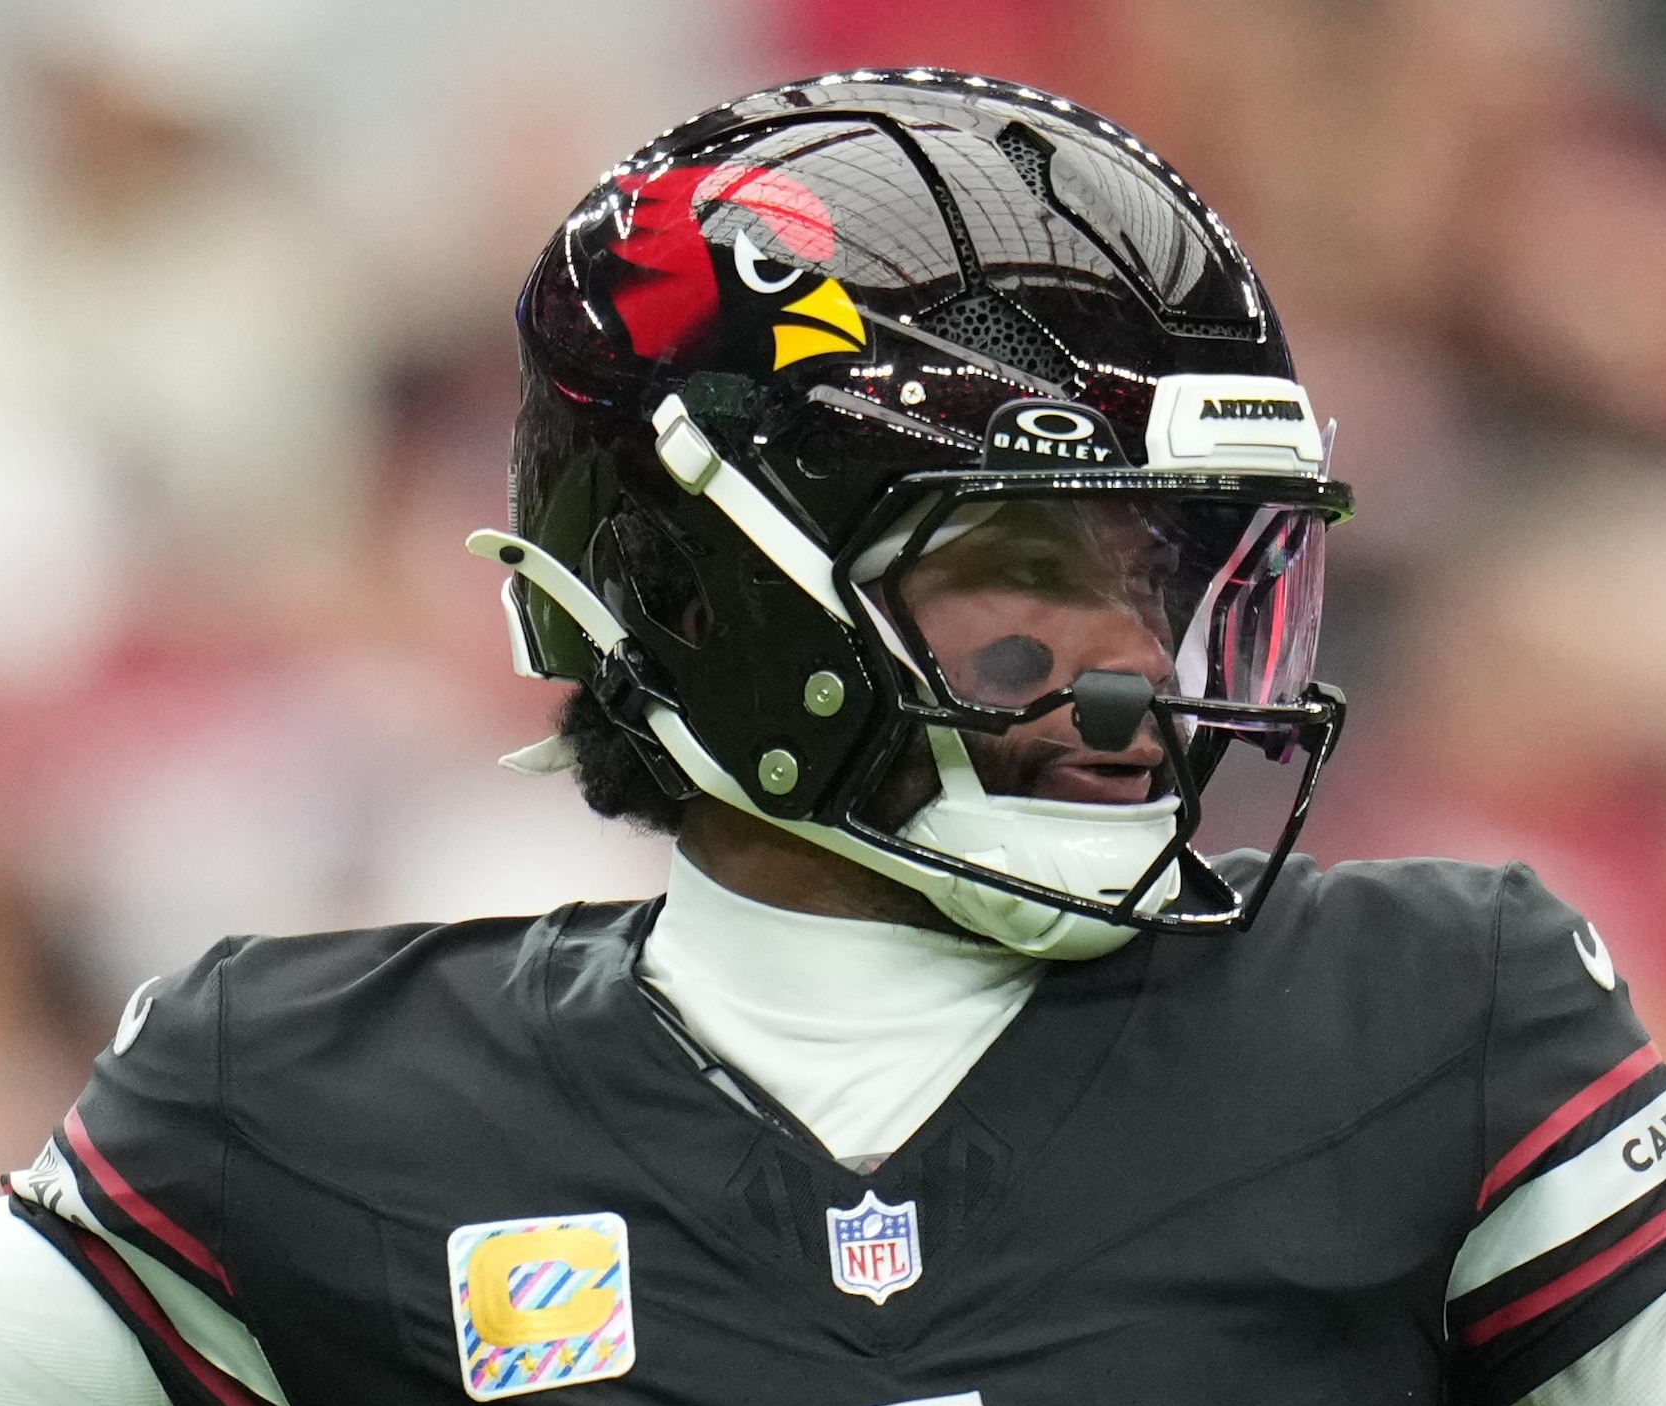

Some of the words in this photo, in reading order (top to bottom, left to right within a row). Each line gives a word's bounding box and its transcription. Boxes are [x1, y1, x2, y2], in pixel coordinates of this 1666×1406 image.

[993, 432, 1110, 463] OAKLEY
[845, 1241, 906, 1283] NFL
[467, 1226, 620, 1349] C
